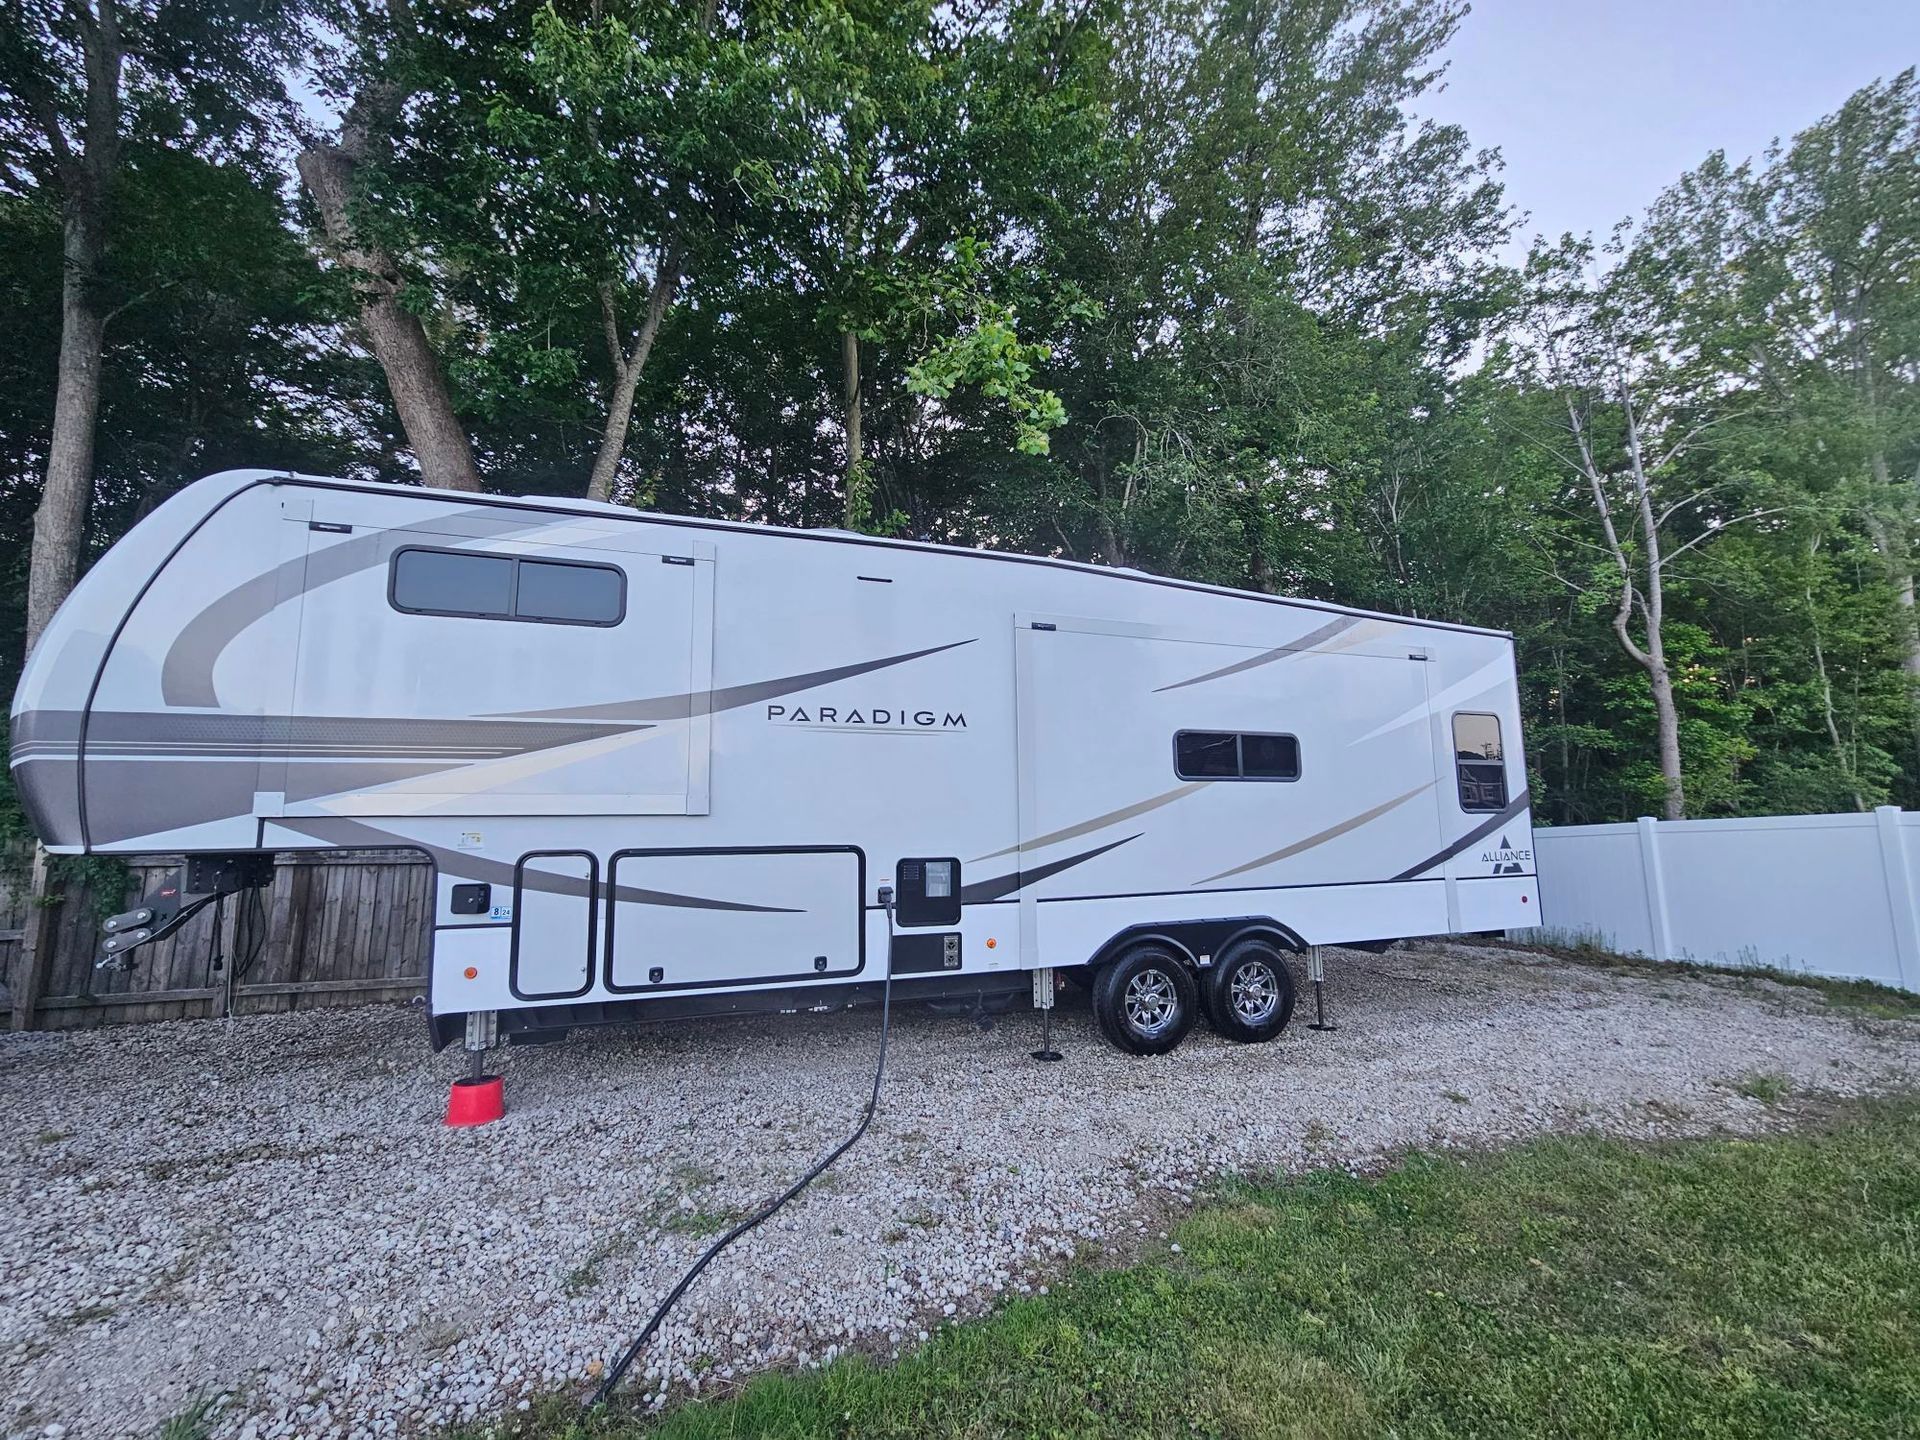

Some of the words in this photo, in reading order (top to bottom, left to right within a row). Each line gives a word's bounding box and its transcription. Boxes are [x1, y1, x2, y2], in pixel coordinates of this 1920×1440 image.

[767, 705, 967, 728] PARADIGM
[1481, 850, 1531, 862] ALLIANCE
[494, 907, 499, 915] 8
